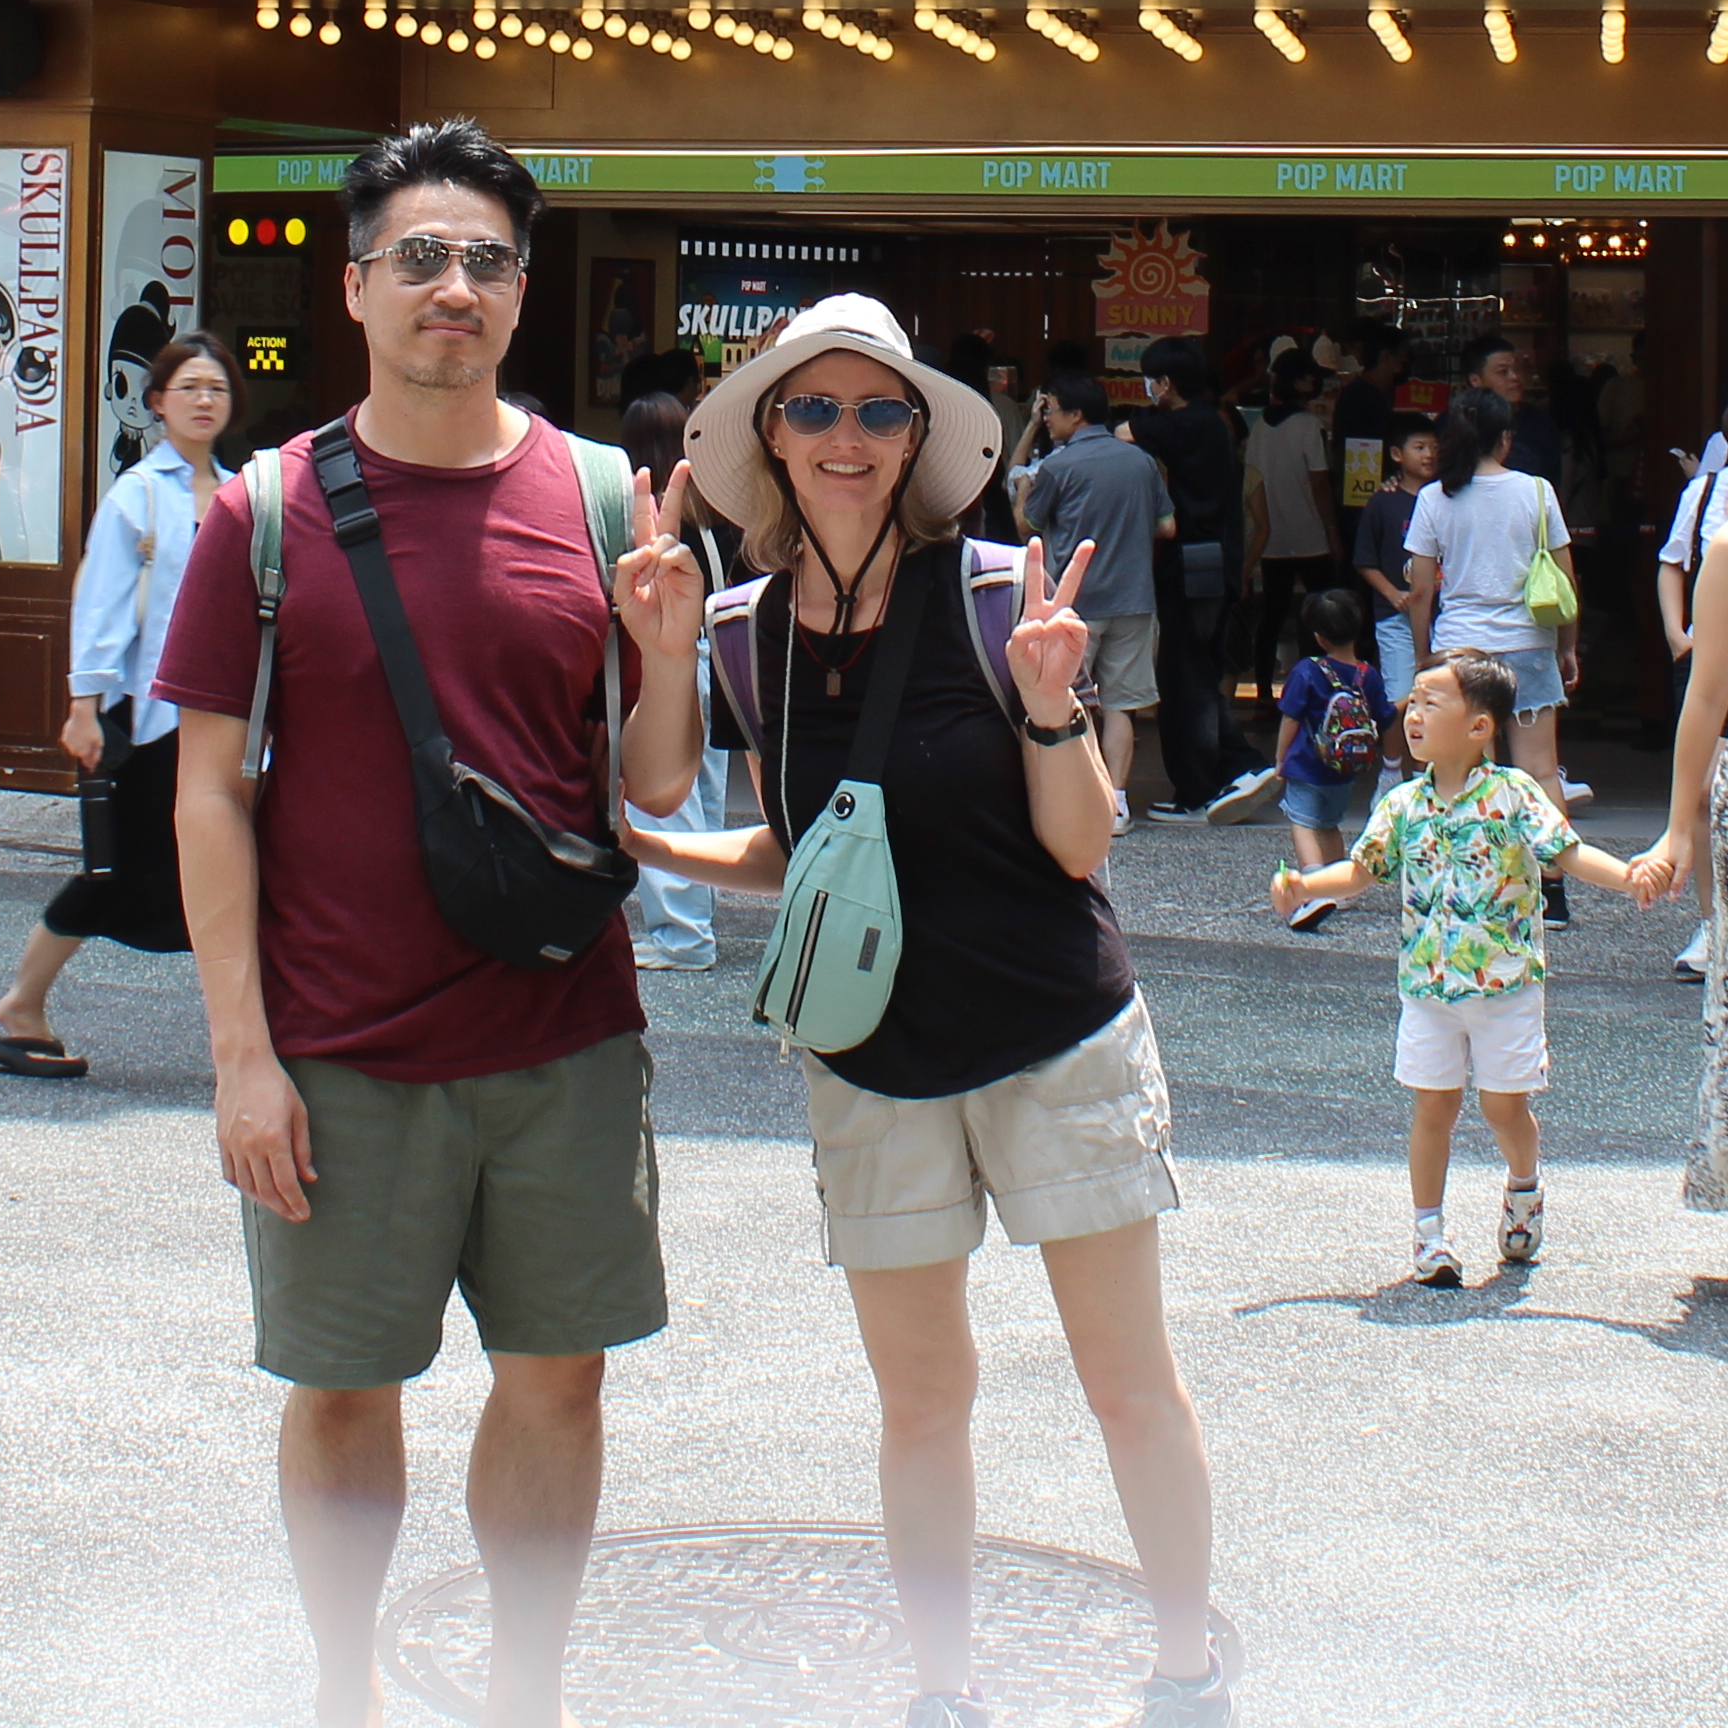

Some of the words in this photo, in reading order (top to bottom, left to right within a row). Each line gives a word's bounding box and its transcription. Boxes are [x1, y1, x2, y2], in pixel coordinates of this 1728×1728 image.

[278, 159, 313, 185] POP
[318, 158, 355, 184] MA
[524, 157, 594, 184] MART
[982, 160, 1033, 189] POP
[1039, 160, 1112, 189] MART
[1276, 163, 1327, 191] POP
[1333, 163, 1408, 191] MART
[1554, 164, 1606, 193] POP
[1613, 164, 1688, 194] MART
[741, 280, 752, 291] POP
[752, 280, 767, 292] MART
[1107, 303, 1196, 327] SUNNY
[246, 336, 287, 349] ACTION!
[1352, 479, 1376, 494] 入口
